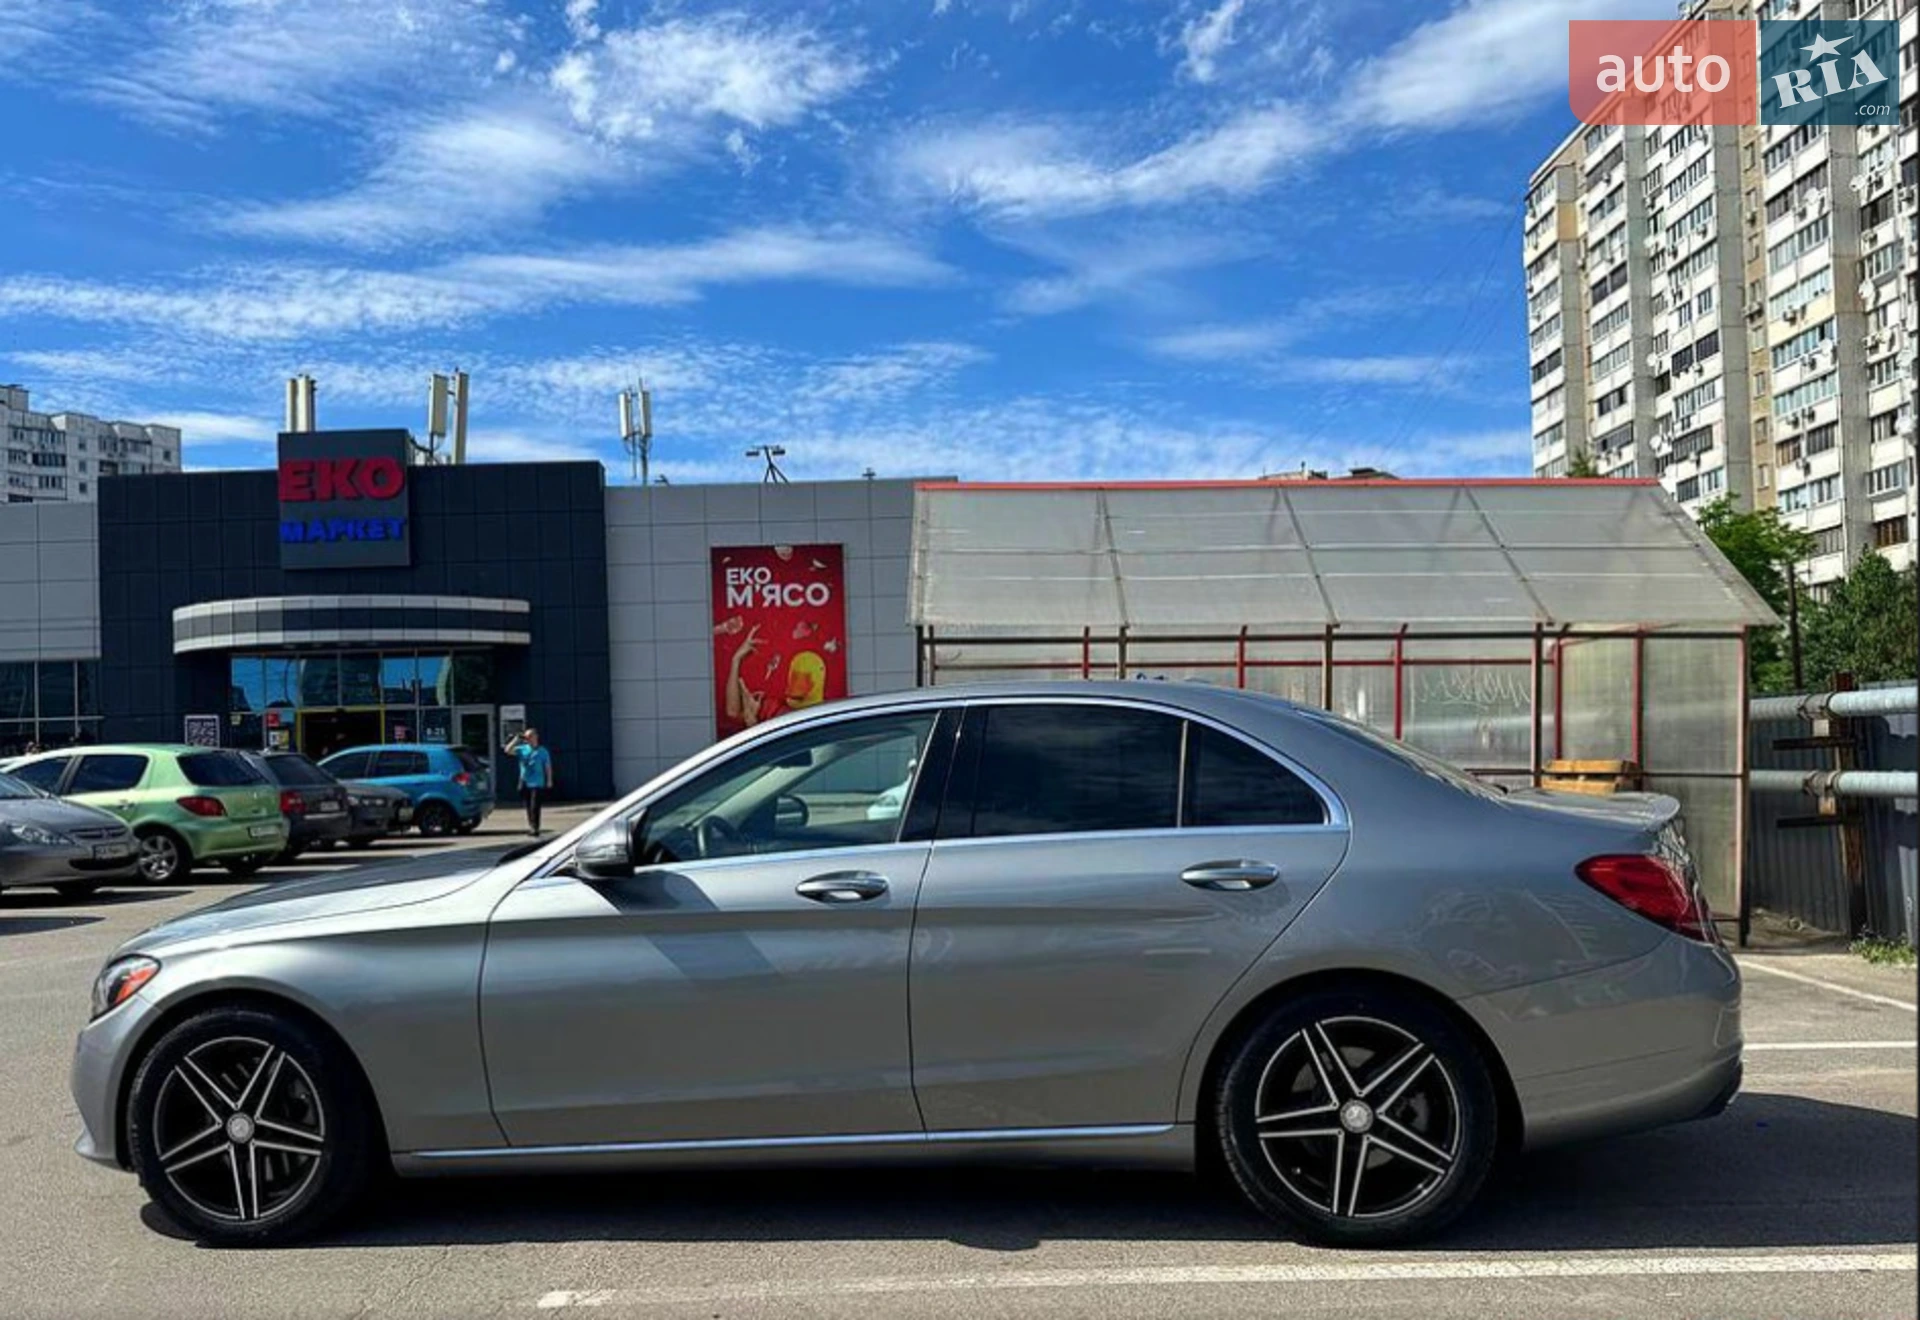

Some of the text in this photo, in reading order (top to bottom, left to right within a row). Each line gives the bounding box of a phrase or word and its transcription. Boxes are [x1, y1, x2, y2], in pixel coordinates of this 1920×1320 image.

[279, 457, 405, 501] ЕКО
[280, 517, 406, 544] МАРКЕТ
[725, 566, 772, 585] ЕКО
